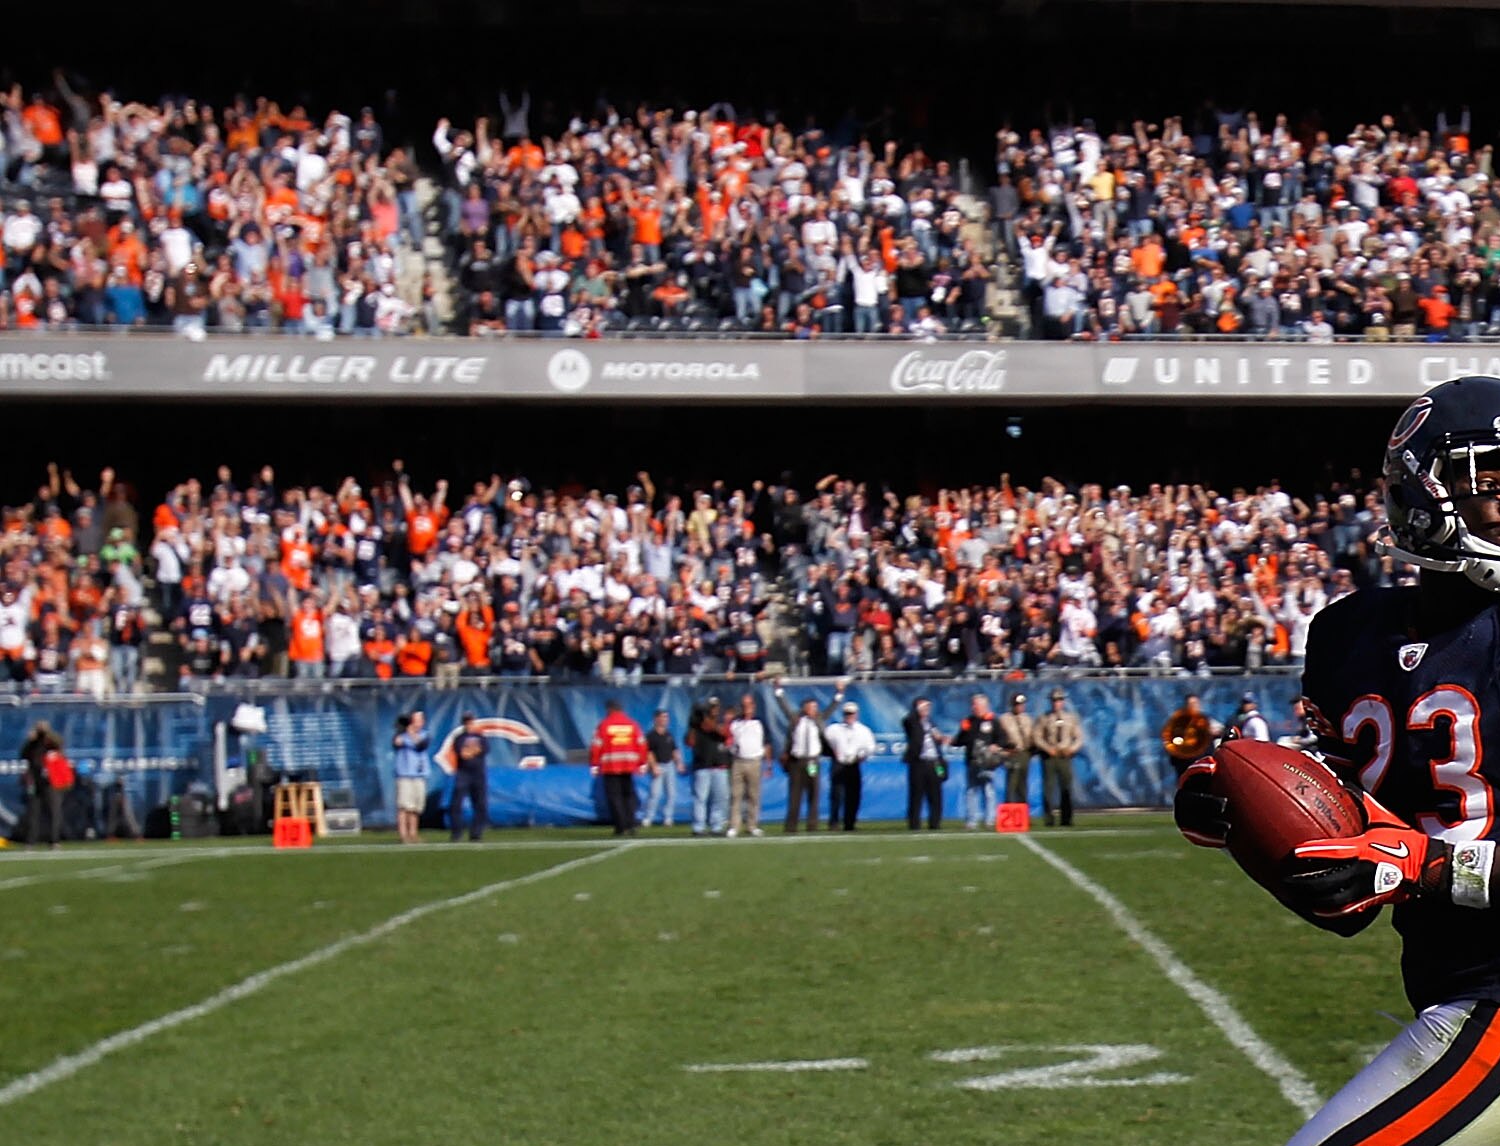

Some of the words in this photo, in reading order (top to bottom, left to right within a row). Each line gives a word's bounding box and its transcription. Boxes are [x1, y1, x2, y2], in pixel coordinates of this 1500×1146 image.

[203, 354, 375, 383] MILLER
[388, 356, 487, 384] LITE
[601, 362, 760, 379] MOTOROLA
[1154, 357, 1375, 385] UNITED
[1282, 762, 1322, 790] NATIONAL
[1341, 683, 1495, 846] 23
[1000, 807, 1024, 828] 20
[1314, 796, 1342, 832] Wilson
